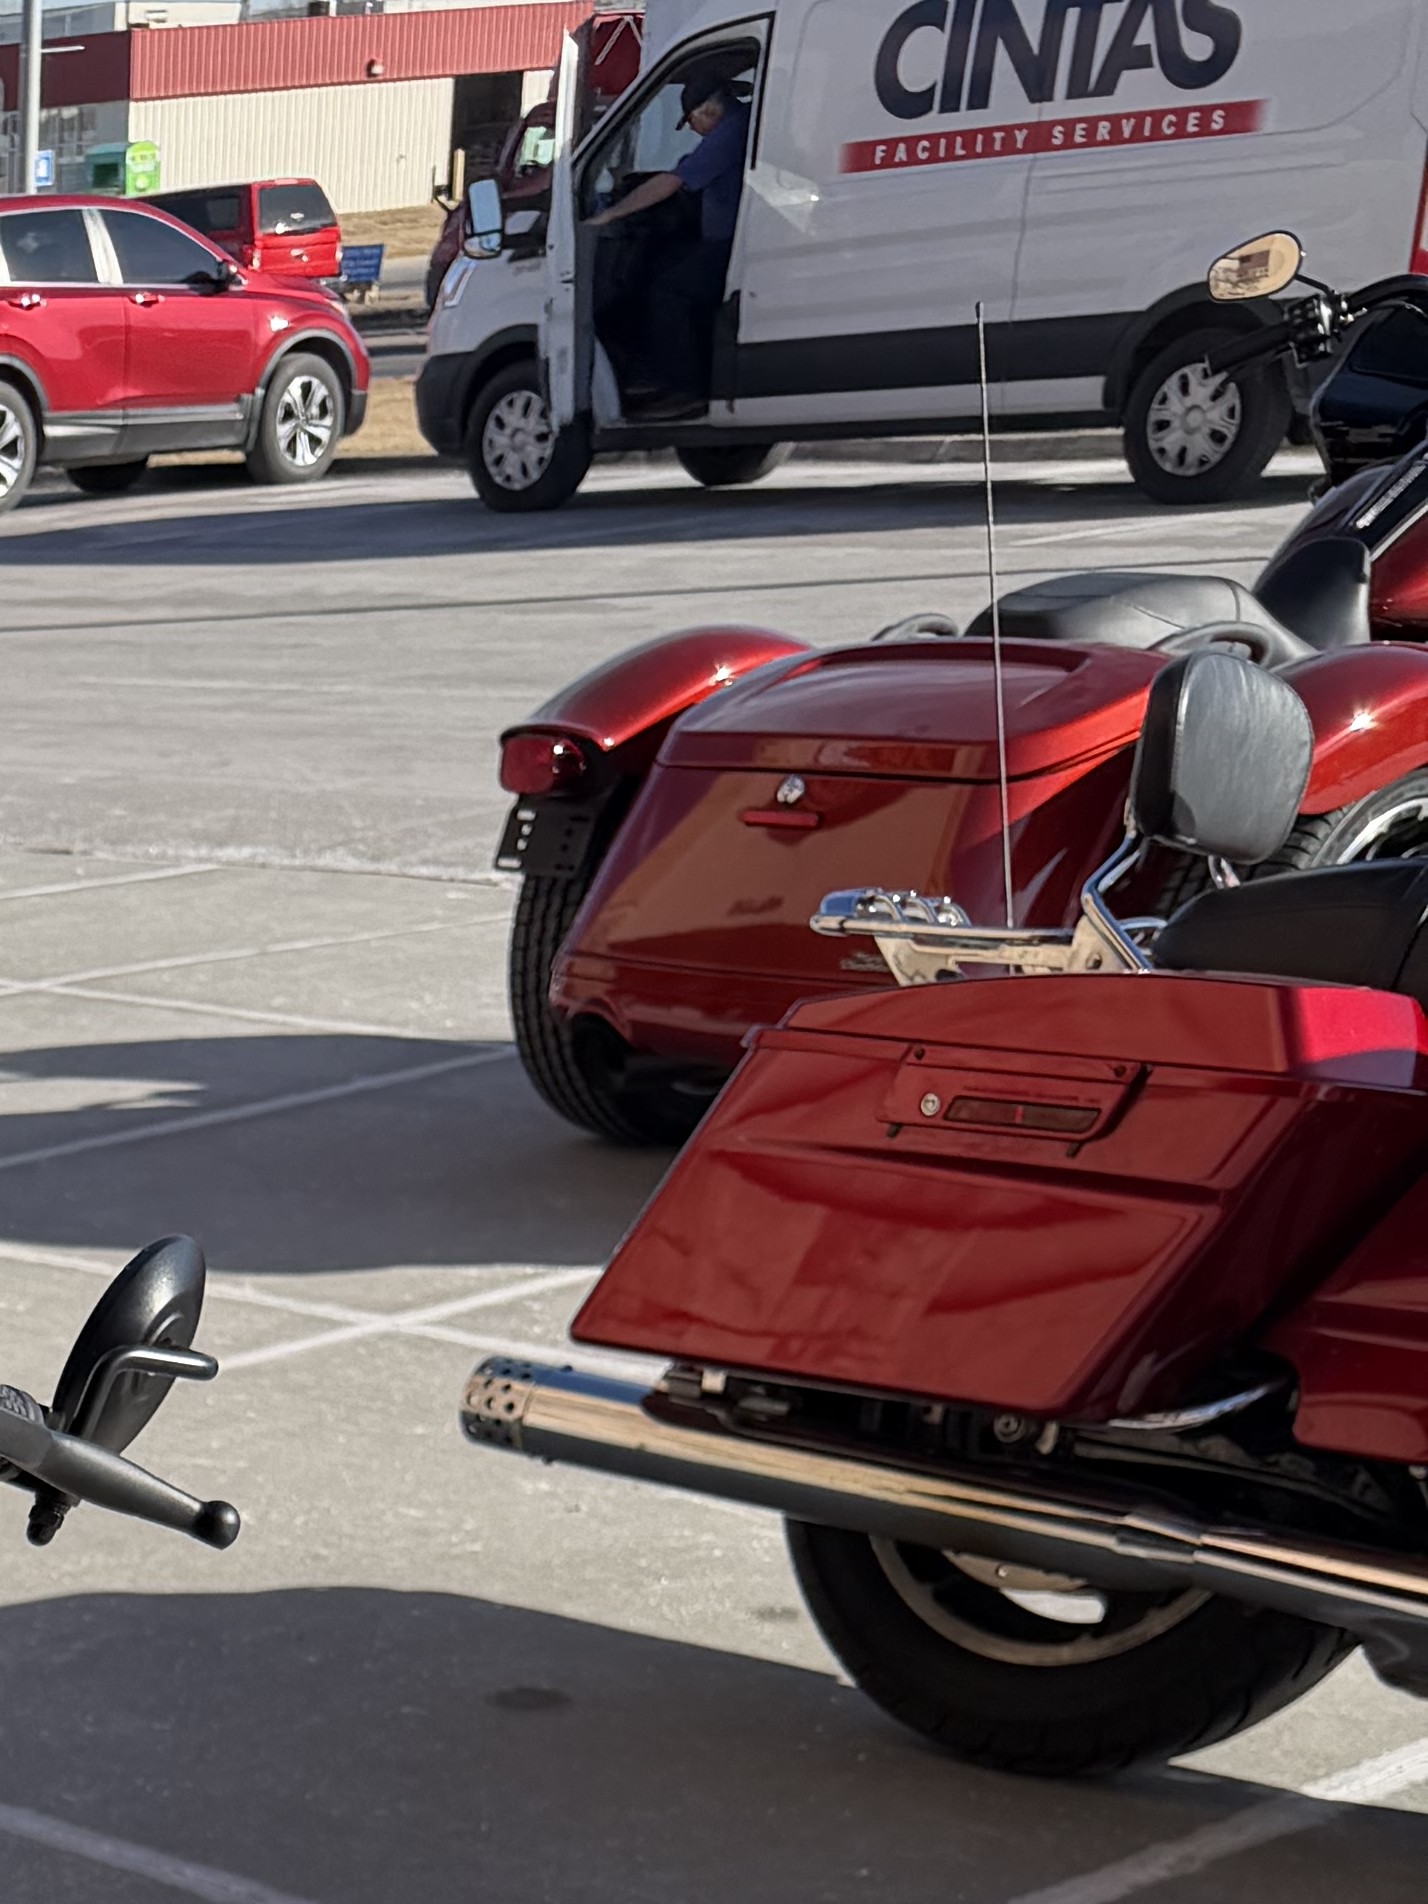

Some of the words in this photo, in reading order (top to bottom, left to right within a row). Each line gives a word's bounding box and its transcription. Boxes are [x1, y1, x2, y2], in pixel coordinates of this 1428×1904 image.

[875, 0, 1242, 120] CINTAS
[874, 128, 1030, 166] FACILITY
[1051, 108, 1228, 147] SERVICES
